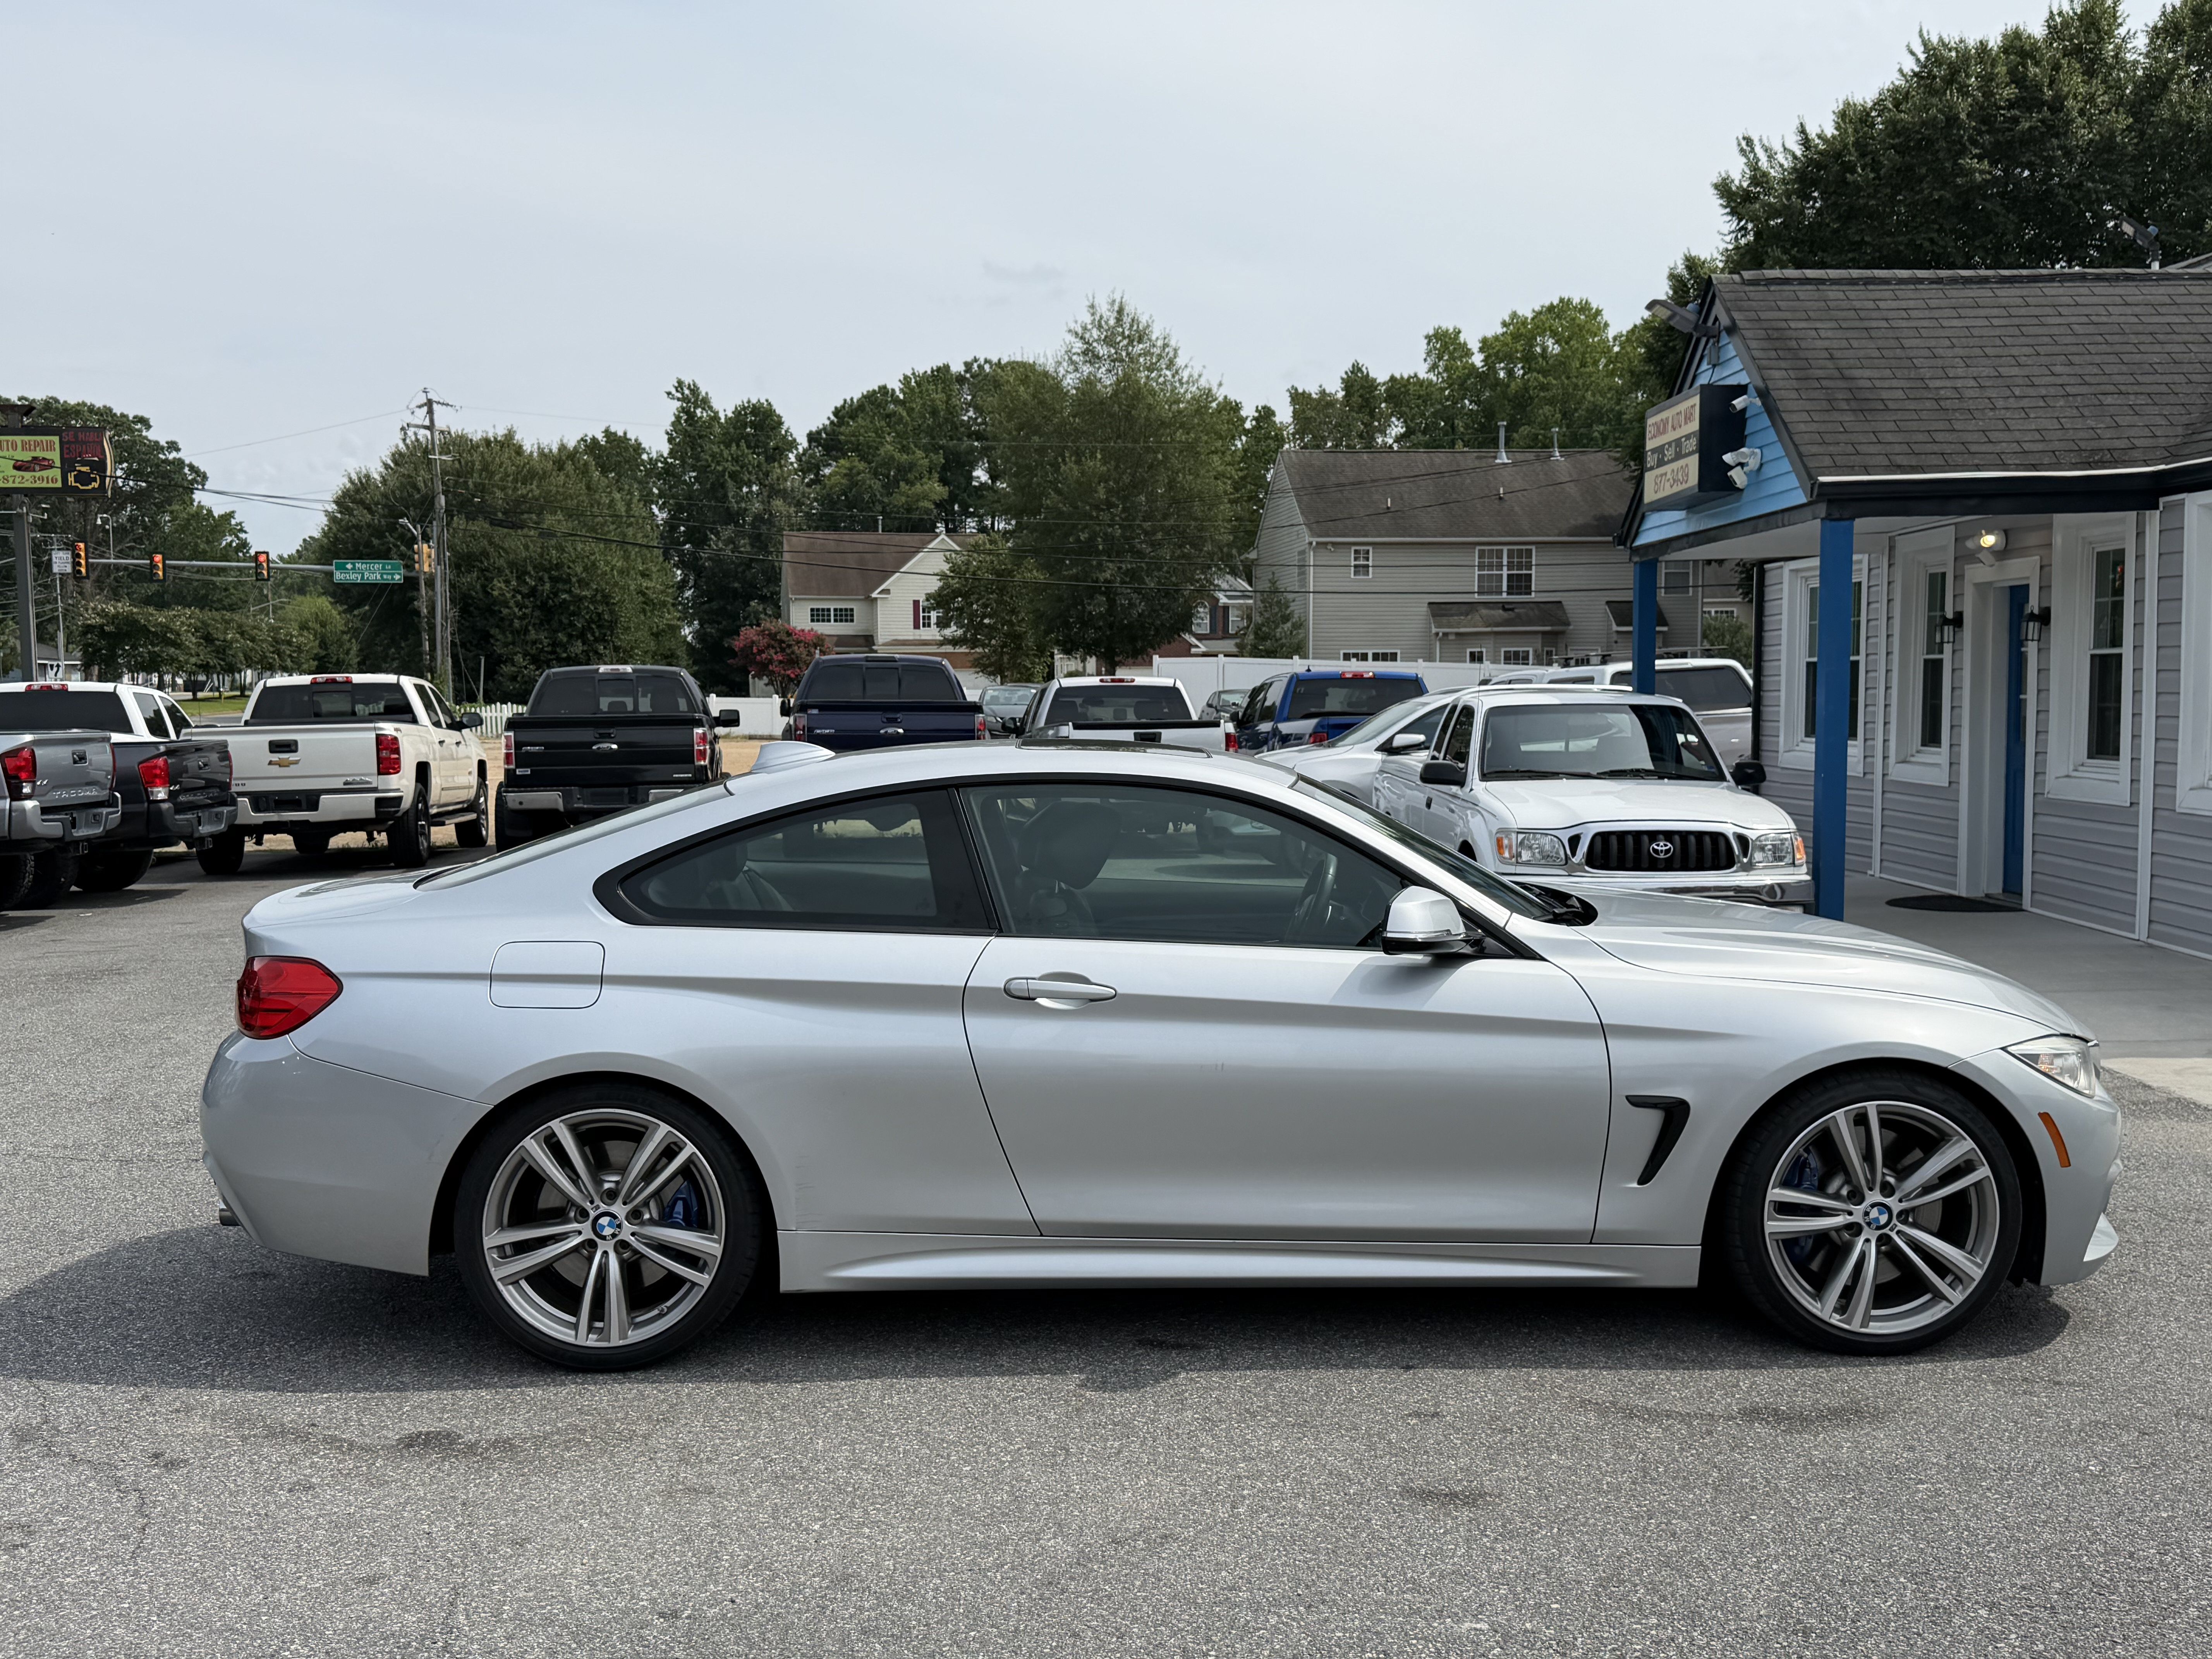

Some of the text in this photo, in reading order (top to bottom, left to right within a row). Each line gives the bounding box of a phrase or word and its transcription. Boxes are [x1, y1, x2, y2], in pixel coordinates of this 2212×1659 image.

[1671, 410, 1682, 432] AUTO
[1683, 403, 1696, 426] MART
[21, 440, 56, 452] REPAIR
[62, 431, 75, 441] SE
[1647, 434, 1696, 468] Buy Sell Trade
[1654, 464, 1689, 494] 877-3439
[336, 571, 361, 582] Bexley
[364, 572, 381, 580] Park
[1864, 1206, 1876, 1229] BMW
[606, 1218, 620, 1240] BMW
